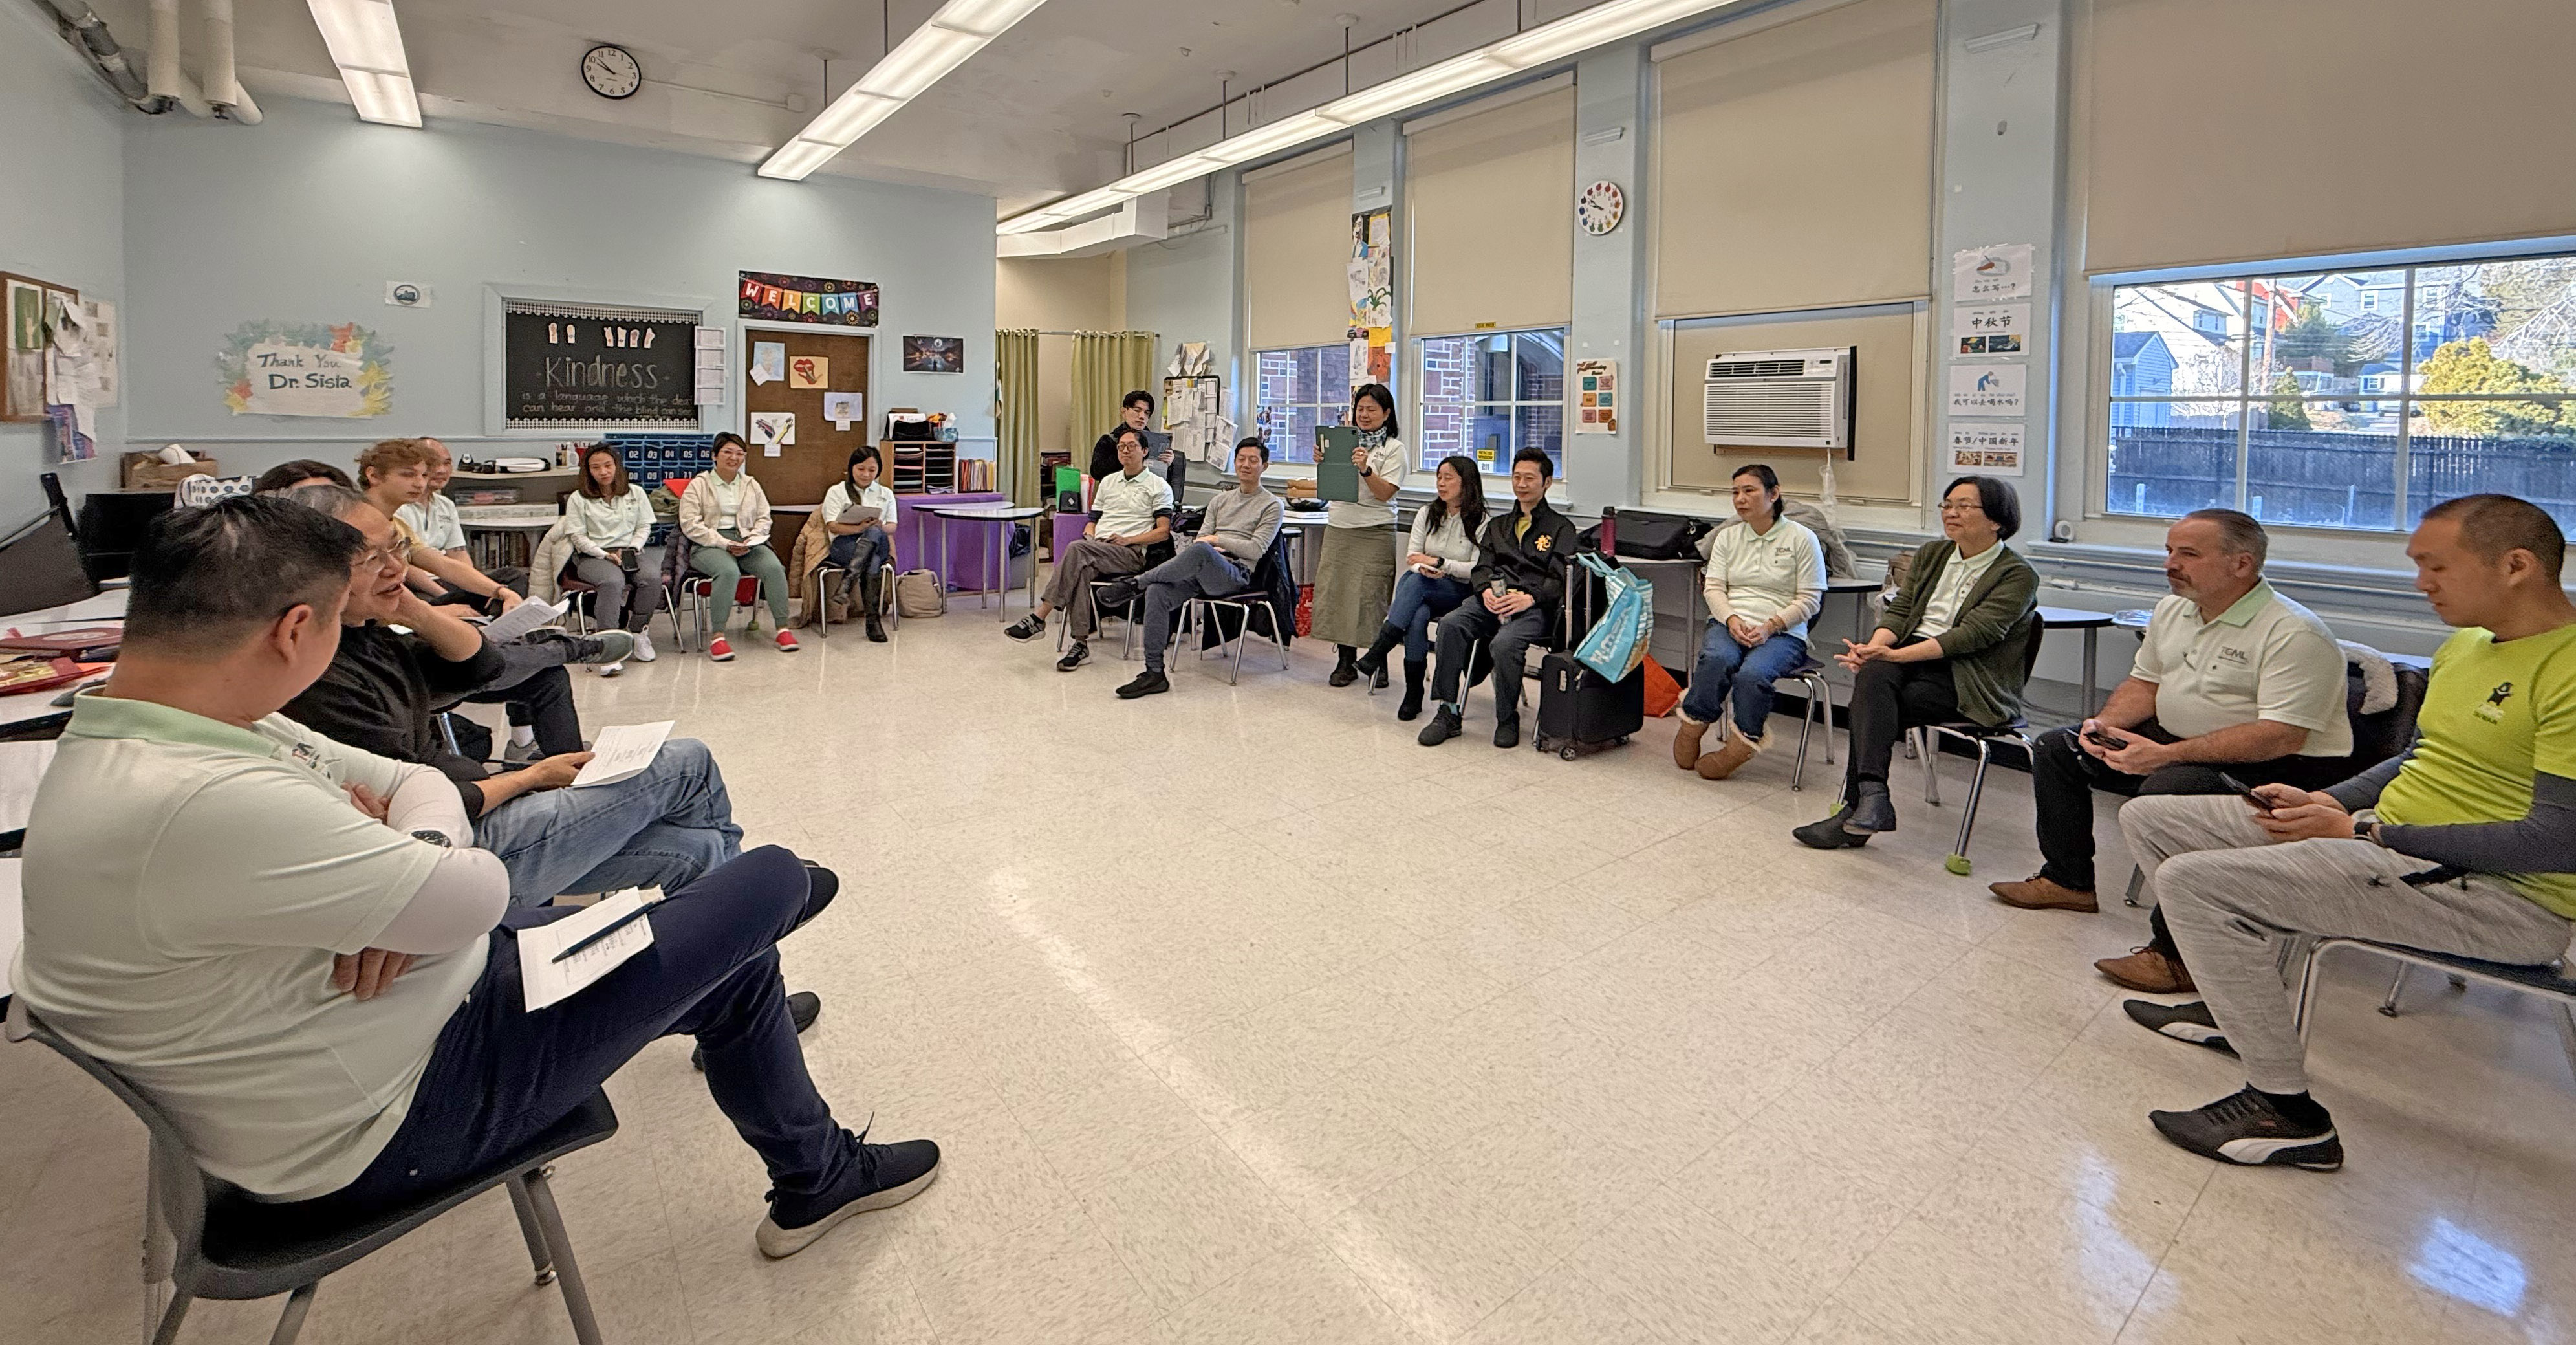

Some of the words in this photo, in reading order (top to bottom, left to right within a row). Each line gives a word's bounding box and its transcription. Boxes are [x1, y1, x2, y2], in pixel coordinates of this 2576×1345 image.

[745, 283, 873, 310] WELCOME
[1971, 315, 2012, 330] 中秋节
[257, 352, 304, 368] Thank
[314, 353, 342, 369] You
[546, 354, 658, 389] Kindness
[268, 373, 299, 389] Dr.
[649, 394, 667, 405] the
[552, 401, 576, 412] hear
[636, 405, 658, 415] blind
[1953, 436, 2019, 446] 春节/中国新年
[629, 450, 639, 459] 02
[647, 450, 658, 459] 03
[683, 450, 693, 459] 05
[629, 472, 638, 481] 08
[664, 471, 674, 479] 10
[684, 471, 692, 479] 11
